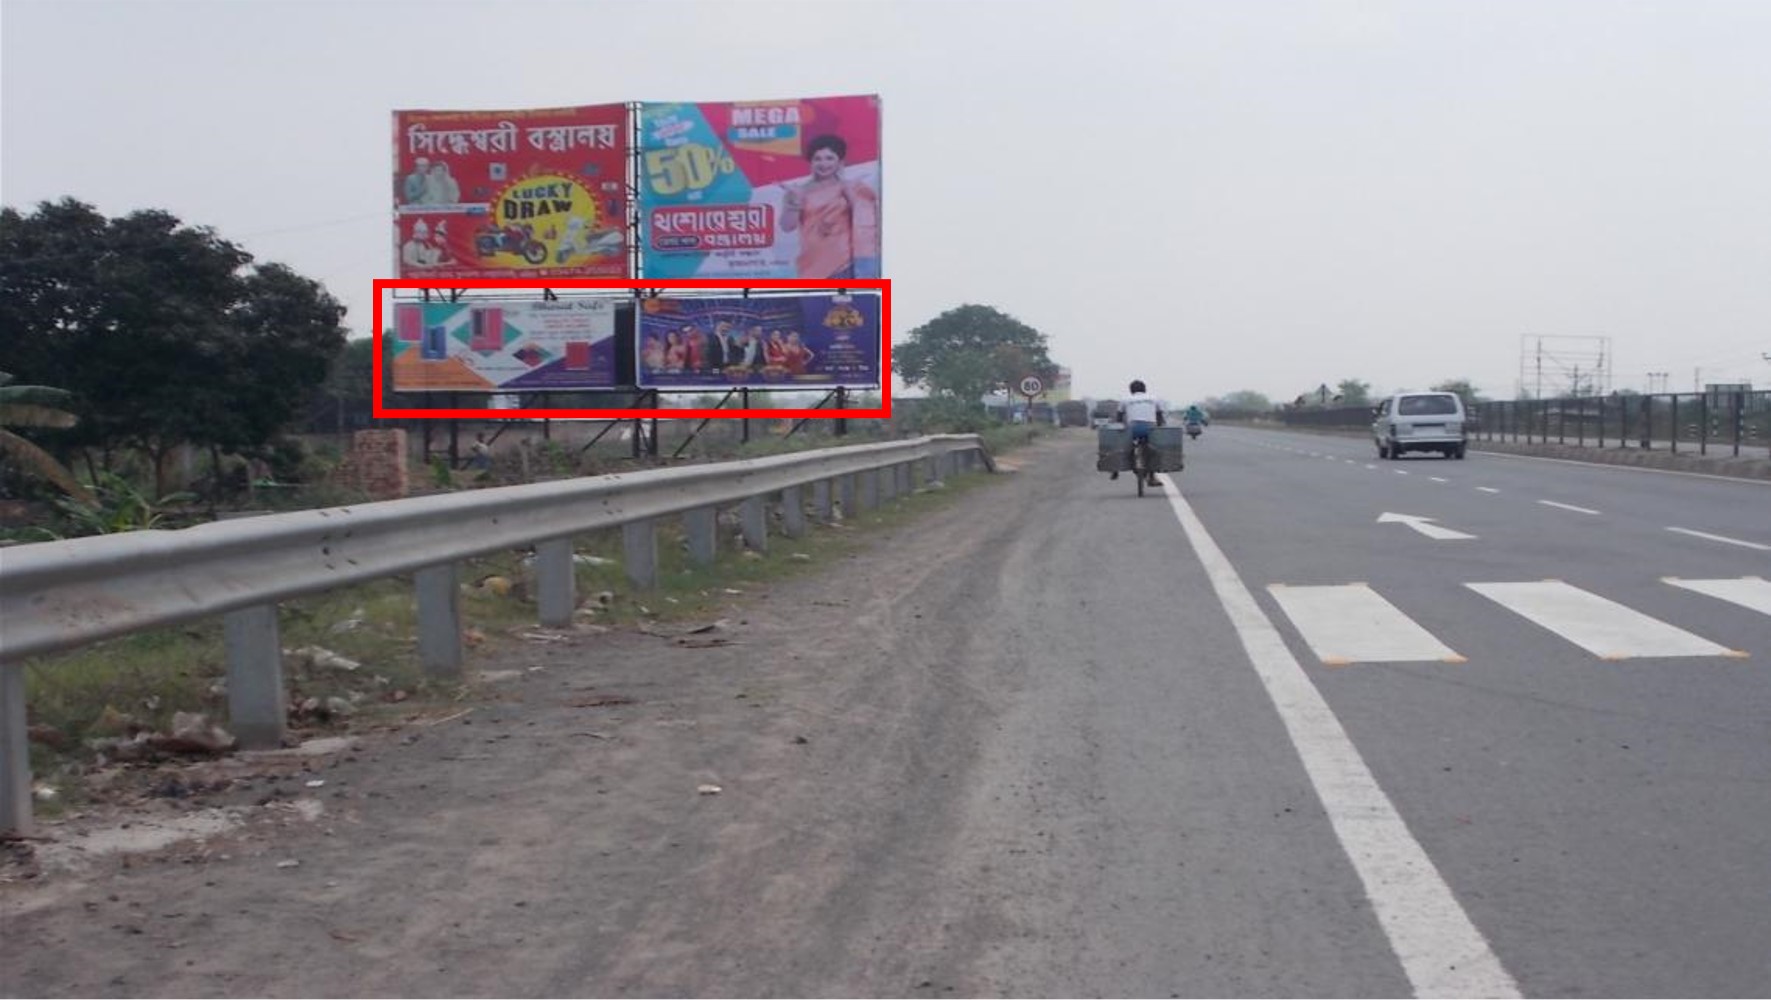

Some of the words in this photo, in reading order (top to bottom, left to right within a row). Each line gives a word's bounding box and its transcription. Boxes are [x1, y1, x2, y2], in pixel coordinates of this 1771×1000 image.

[732, 107, 799, 126] MEGA
[408, 121, 518, 154] সিদ্ধেশ্বরী
[526, 125, 618, 151] বস্ত্রালয়
[737, 128, 776, 139] SALE
[645, 143, 735, 195] 50%
[512, 182, 573, 199] LUCKY
[504, 199, 573, 219] DRAW
